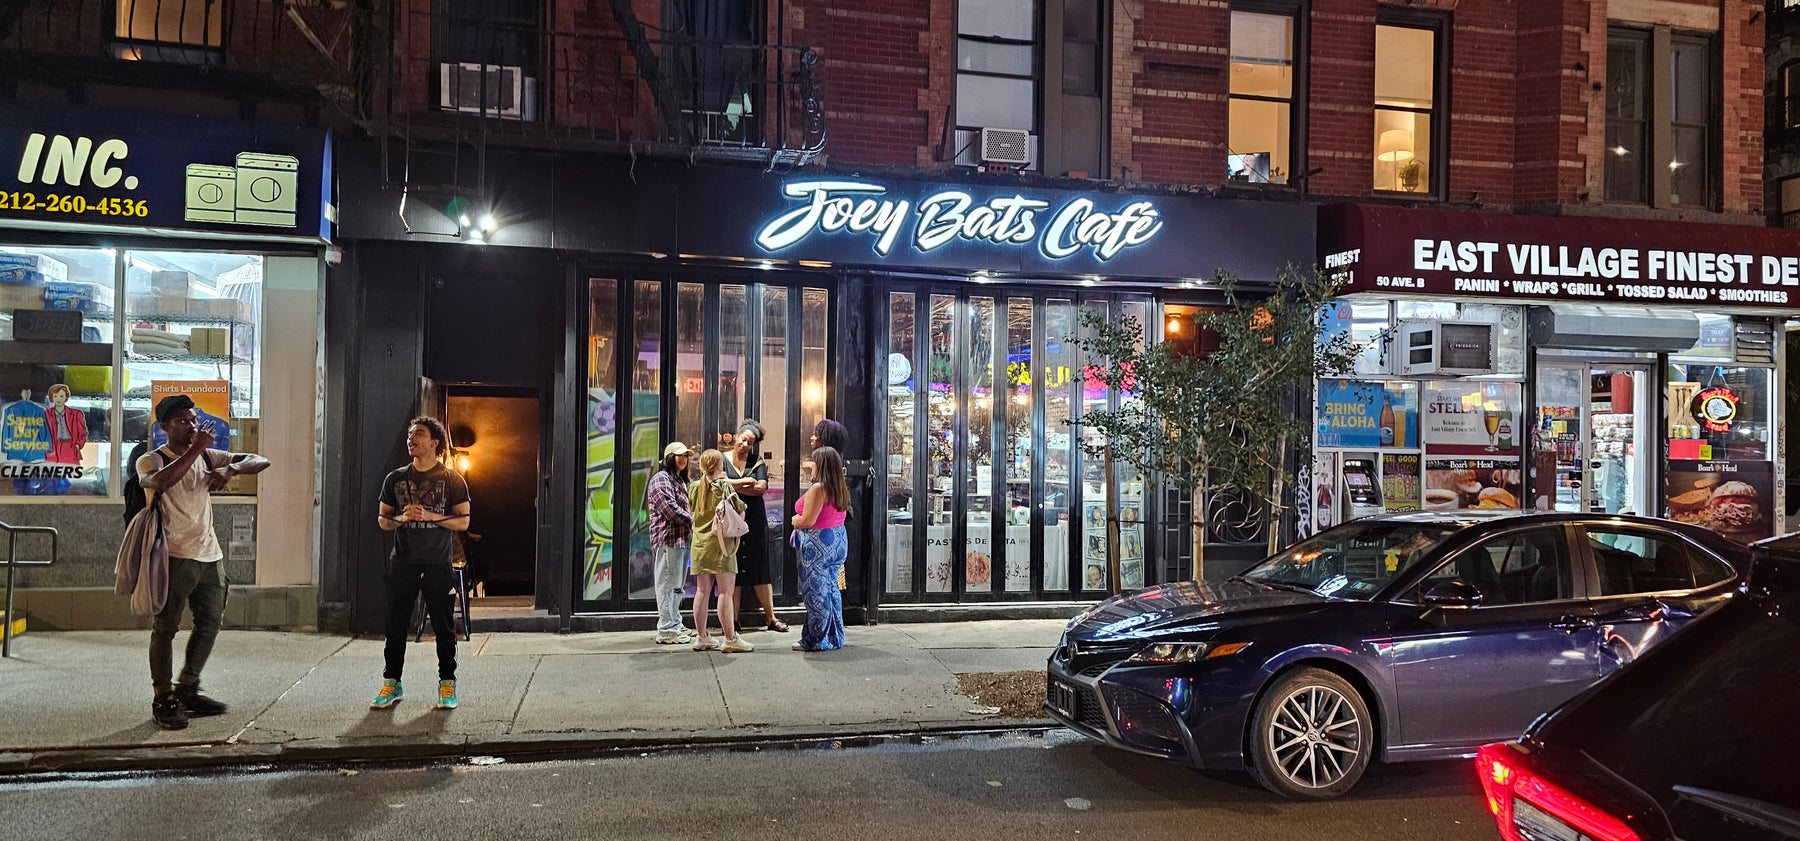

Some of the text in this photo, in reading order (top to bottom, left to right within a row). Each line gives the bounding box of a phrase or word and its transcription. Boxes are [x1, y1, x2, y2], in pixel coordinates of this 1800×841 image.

[18, 133, 139, 190] INC.
[0, 191, 149, 217] 212-260-4536
[755, 180, 1163, 261] Joey Bats Café
[1325, 249, 1361, 269] FINEST
[1414, 239, 1800, 286] EAST VILLAGE FINEST DE
[1376, 276, 1425, 288] 50 AVE. B
[1455, 278, 1500, 293] PANINI
[1512, 281, 1559, 295] WRAPS
[1616, 284, 1666, 299] TOSSED
[1667, 286, 1708, 300] SALAD
[1719, 288, 1789, 304] SMOOTHIES
[19, 316, 76, 334] OPEN
[153, 385, 227, 393] Shirts Laundered
[1325, 402, 1366, 415] BRING
[7, 413, 44, 427] Same
[1331, 415, 1376, 428] ALOHA
[14, 426, 39, 442] Day
[1318, 433, 1340, 446] ATM
[5, 438, 50, 451] Service
[1397, 455, 1418, 463] GOOD
[1477, 461, 1494, 469] Head
[1, 465, 84, 479] CLEANERS
[1698, 464, 1738, 472] Boar's Head
[975, 537, 987, 545] DE
